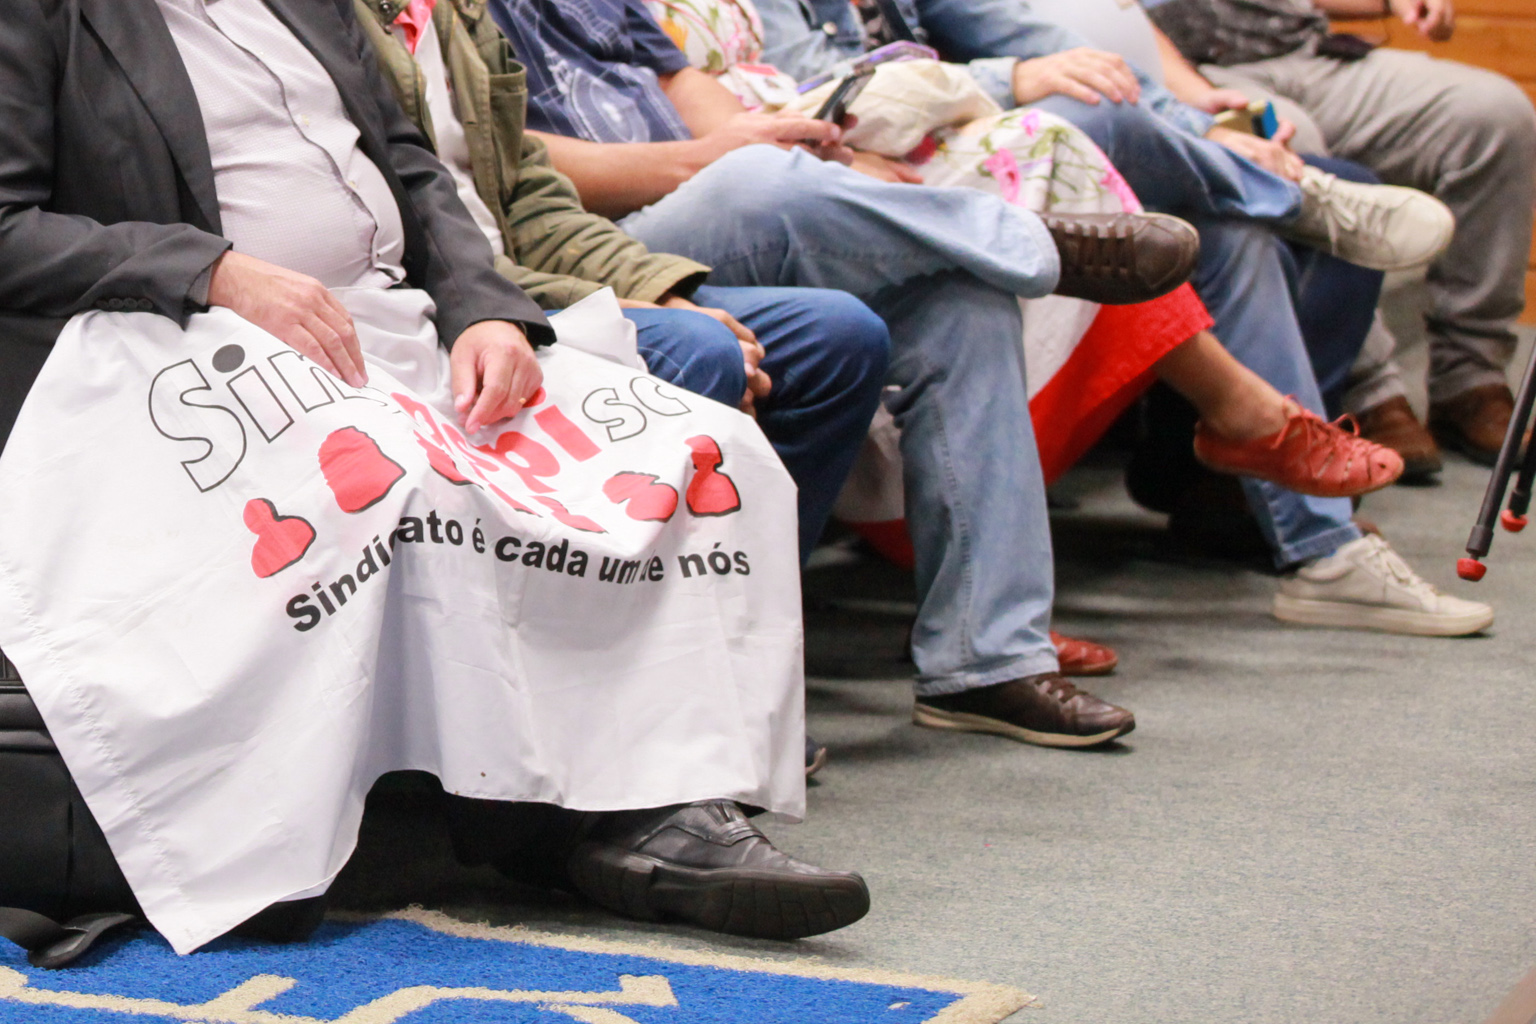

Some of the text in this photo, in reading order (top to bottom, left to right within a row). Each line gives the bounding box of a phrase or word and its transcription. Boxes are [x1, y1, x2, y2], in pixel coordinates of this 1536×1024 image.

[472, 518, 486, 554] é
[494, 536, 589, 578] cada
[598, 556, 641, 584] um
[677, 542, 751, 578] nós
